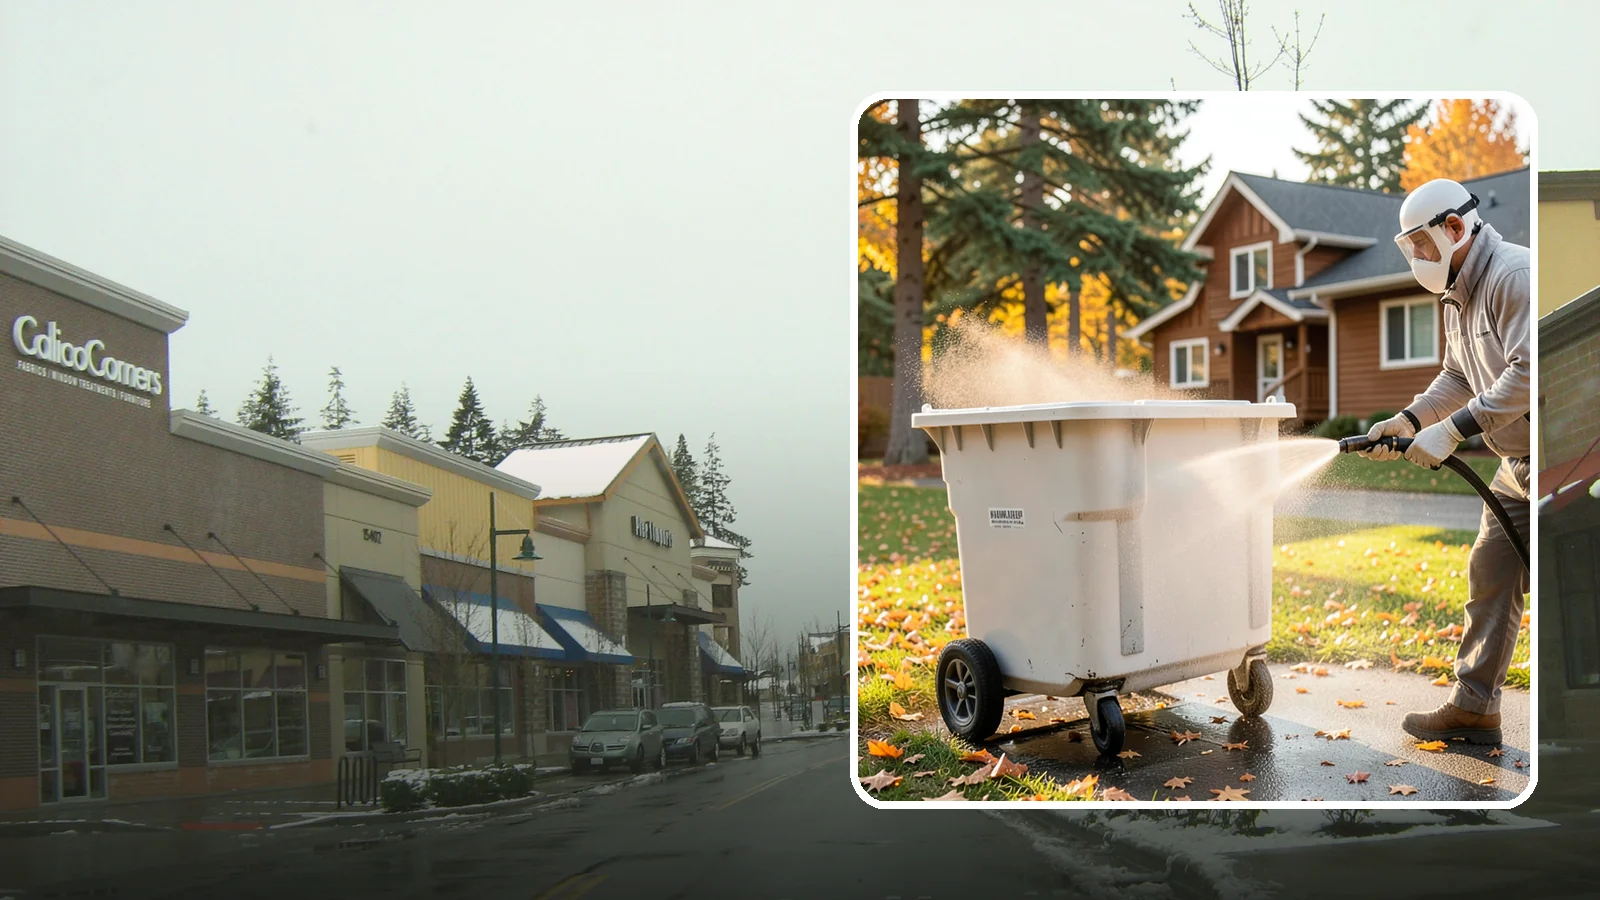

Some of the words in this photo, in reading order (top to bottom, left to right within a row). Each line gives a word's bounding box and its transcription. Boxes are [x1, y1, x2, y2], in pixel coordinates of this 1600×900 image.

[17, 360, 47, 377] FABRICS
[52, 370, 78, 386] WINDOW
[78, 378, 116, 398] TREATMENTS
